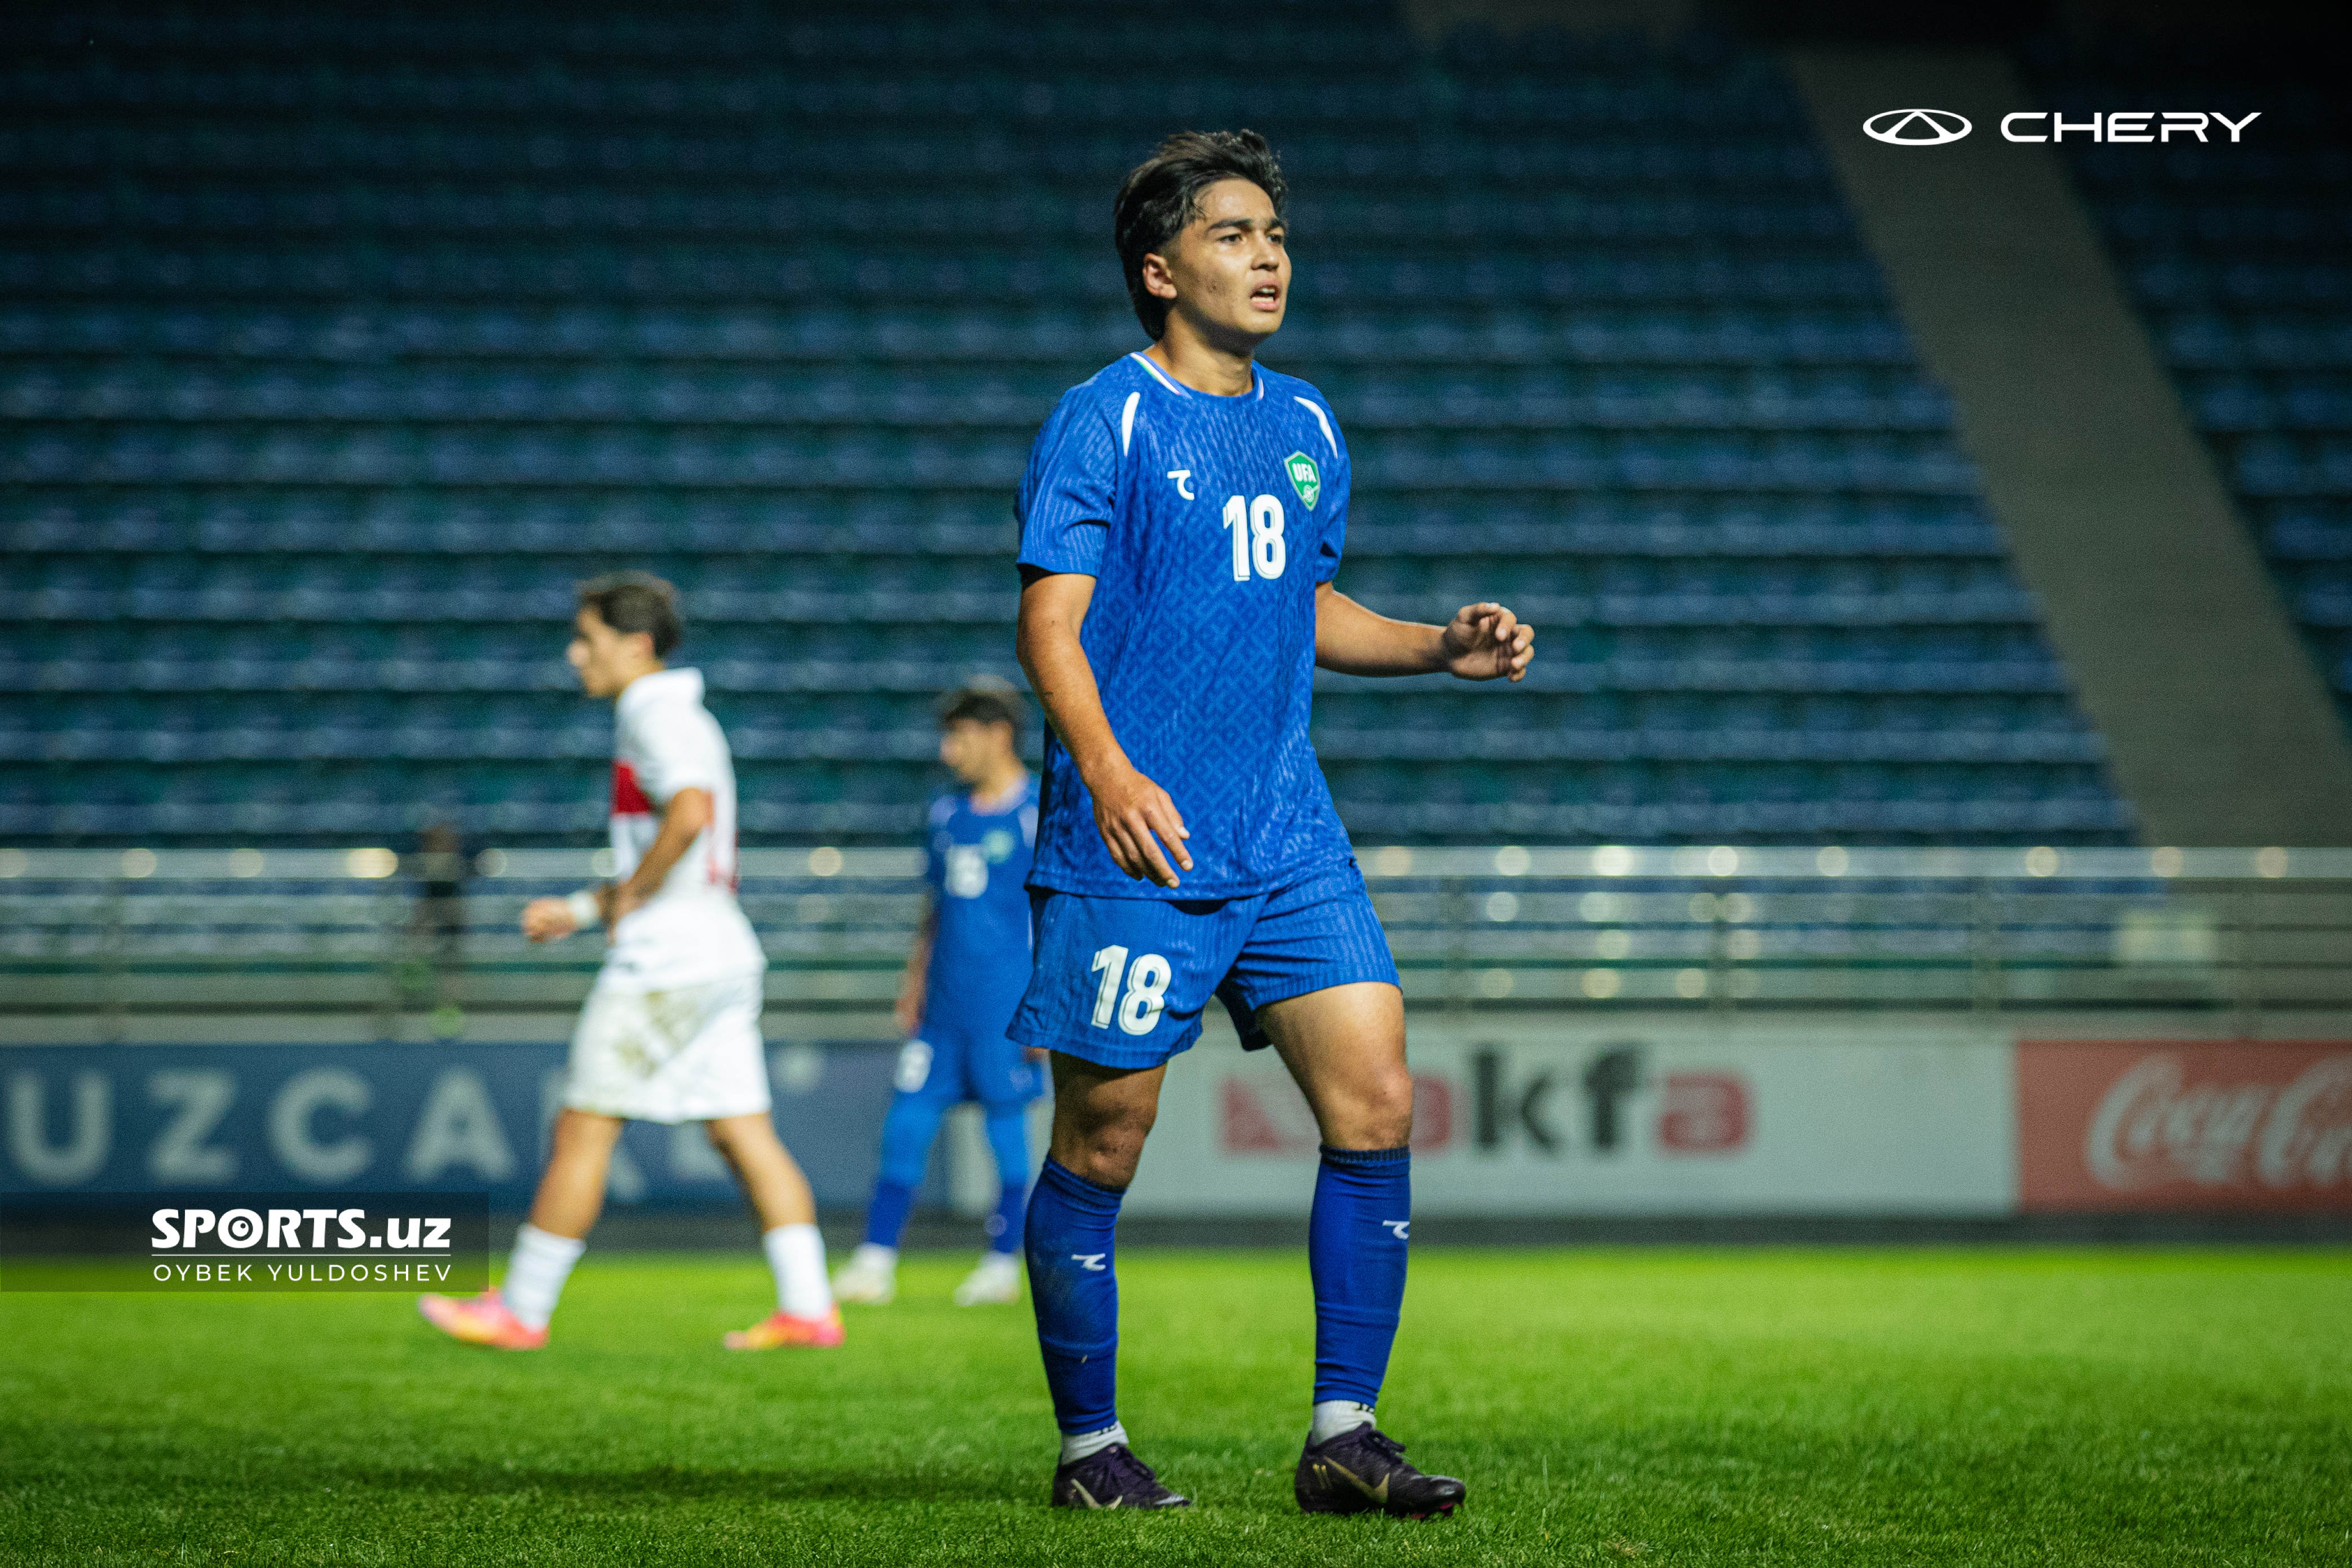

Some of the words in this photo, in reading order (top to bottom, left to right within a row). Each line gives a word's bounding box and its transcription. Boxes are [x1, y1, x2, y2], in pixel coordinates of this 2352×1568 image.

[1292, 462, 1317, 483] UFA
[1222, 493, 1286, 582] 18
[1091, 944, 1172, 1036] 18
[8, 1066, 732, 1191] UZCA
